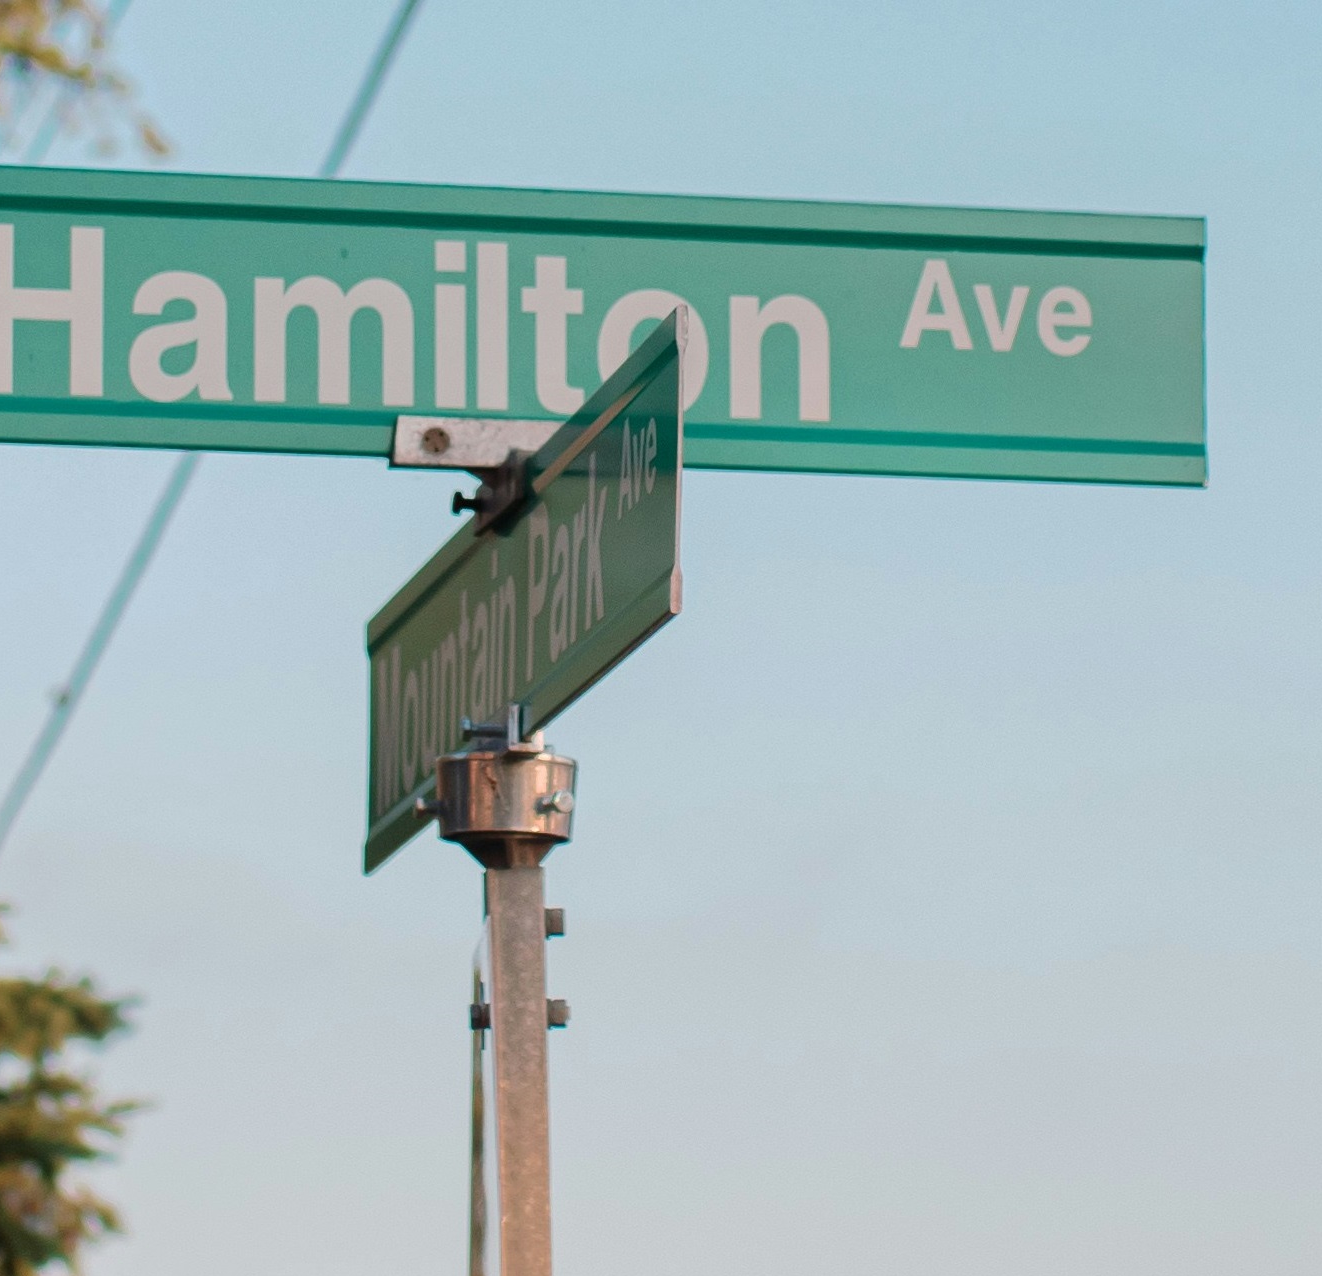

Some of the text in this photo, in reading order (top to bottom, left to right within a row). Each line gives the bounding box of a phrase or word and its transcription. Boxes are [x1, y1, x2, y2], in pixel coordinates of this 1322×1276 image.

[900, 259, 1093, 357] Ave
[377, 416, 658, 812] Mountain Park Ave
